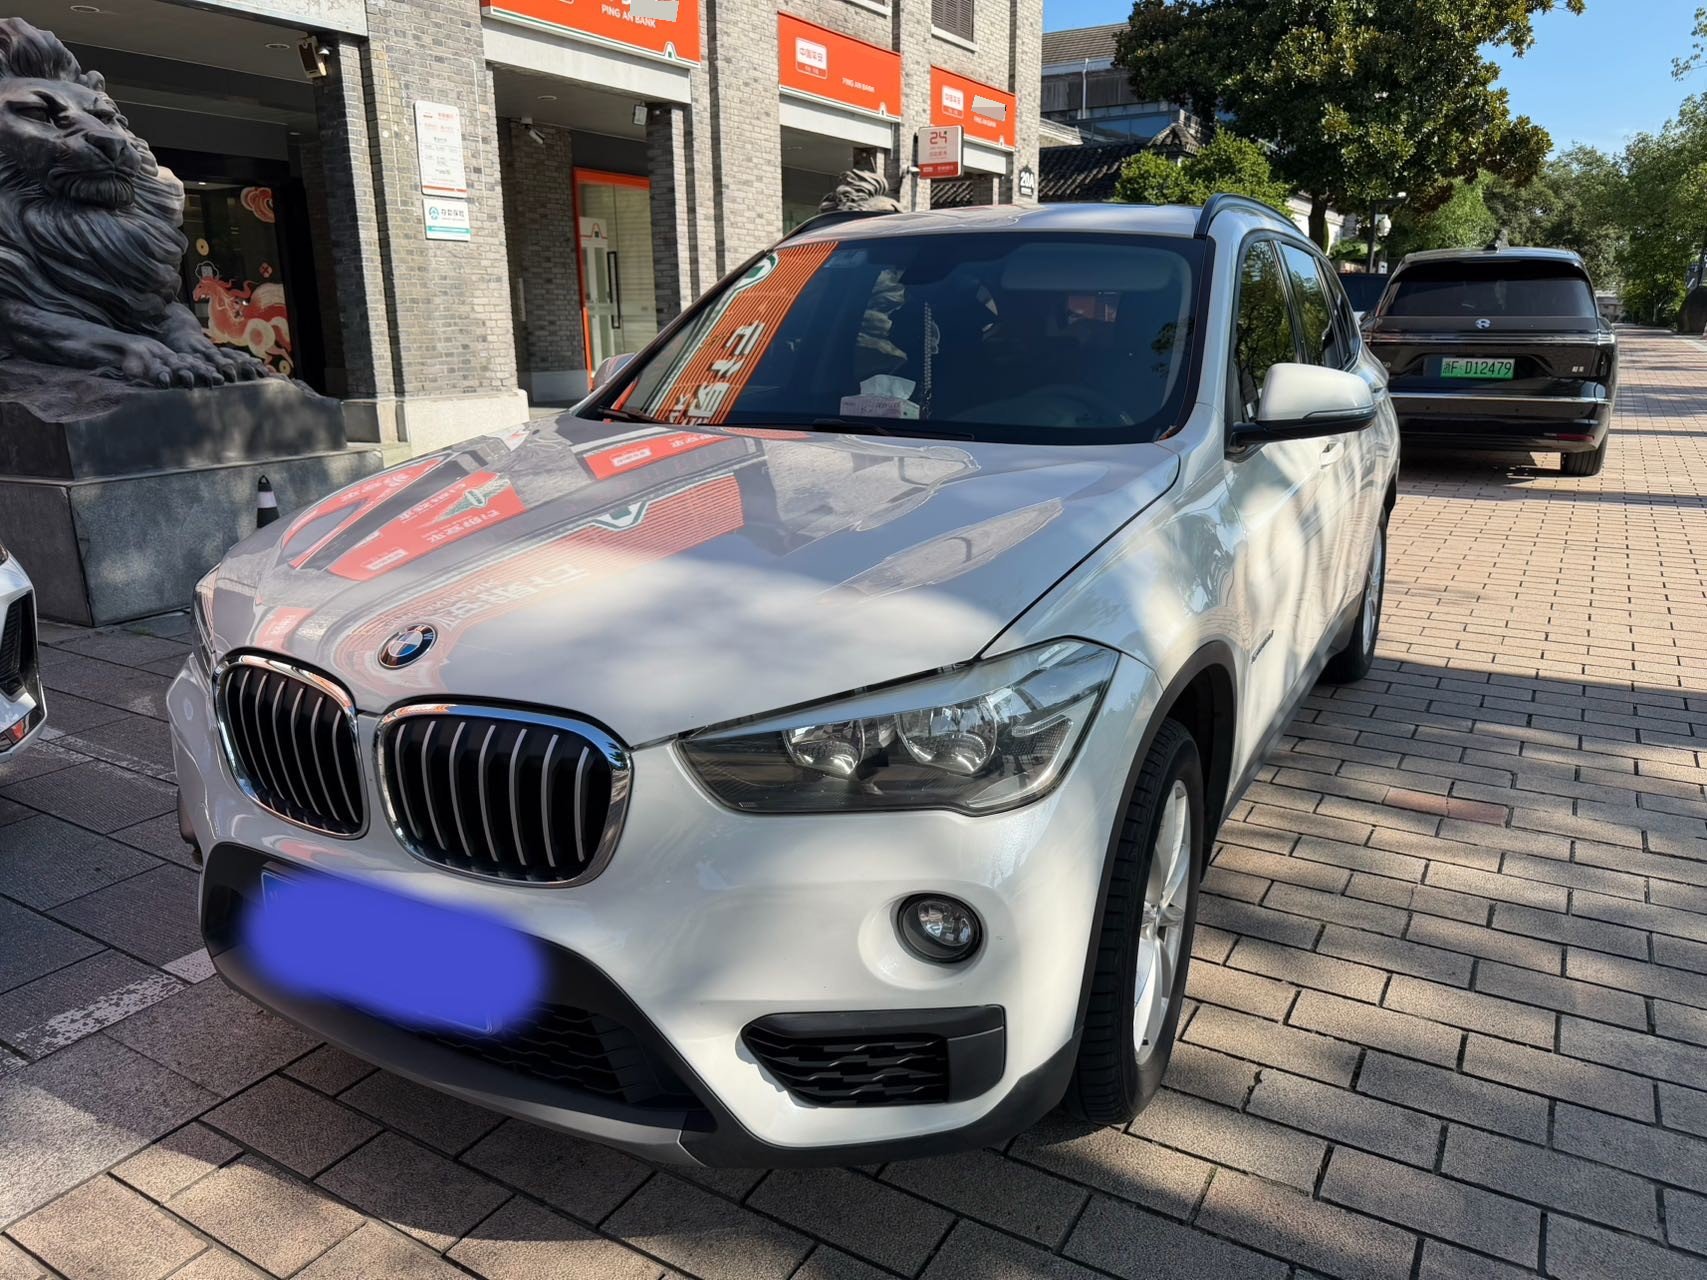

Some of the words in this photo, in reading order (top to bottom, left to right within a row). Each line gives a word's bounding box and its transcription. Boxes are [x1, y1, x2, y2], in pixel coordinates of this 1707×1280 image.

[602, 4, 621, 18] PING
[622, 10, 634, 23] AN
[635, 15, 657, 29] BANK
[1020, 171, 1035, 188] 20A
